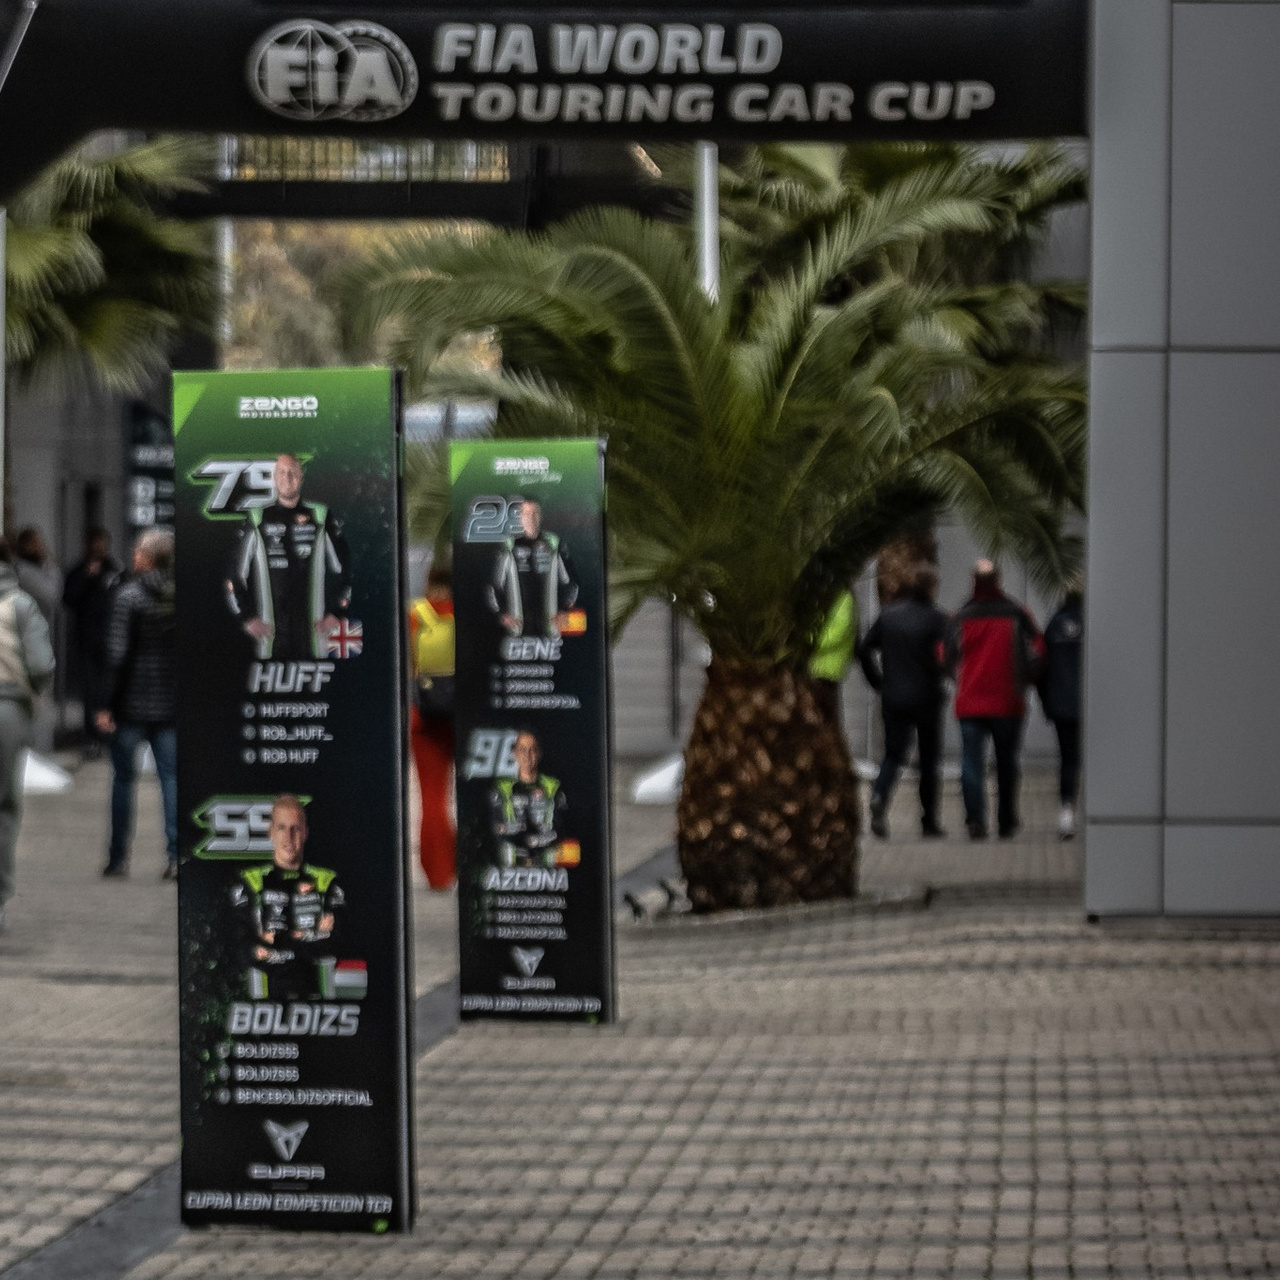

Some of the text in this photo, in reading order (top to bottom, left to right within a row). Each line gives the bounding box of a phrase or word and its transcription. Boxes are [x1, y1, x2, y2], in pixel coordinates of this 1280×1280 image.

[435, 22, 783, 75] FIA WORLD
[433, 80, 995, 122] TOURING CAR CUP
[193, 460, 278, 512] 79
[249, 662, 335, 693] HUFF
[260, 702, 330, 718] HUFFSPORT
[260, 747, 320, 764] ROB HUFF
[229, 1002, 360, 1037] BOLDIZS
[186, 1190, 232, 1210] CUPRA
